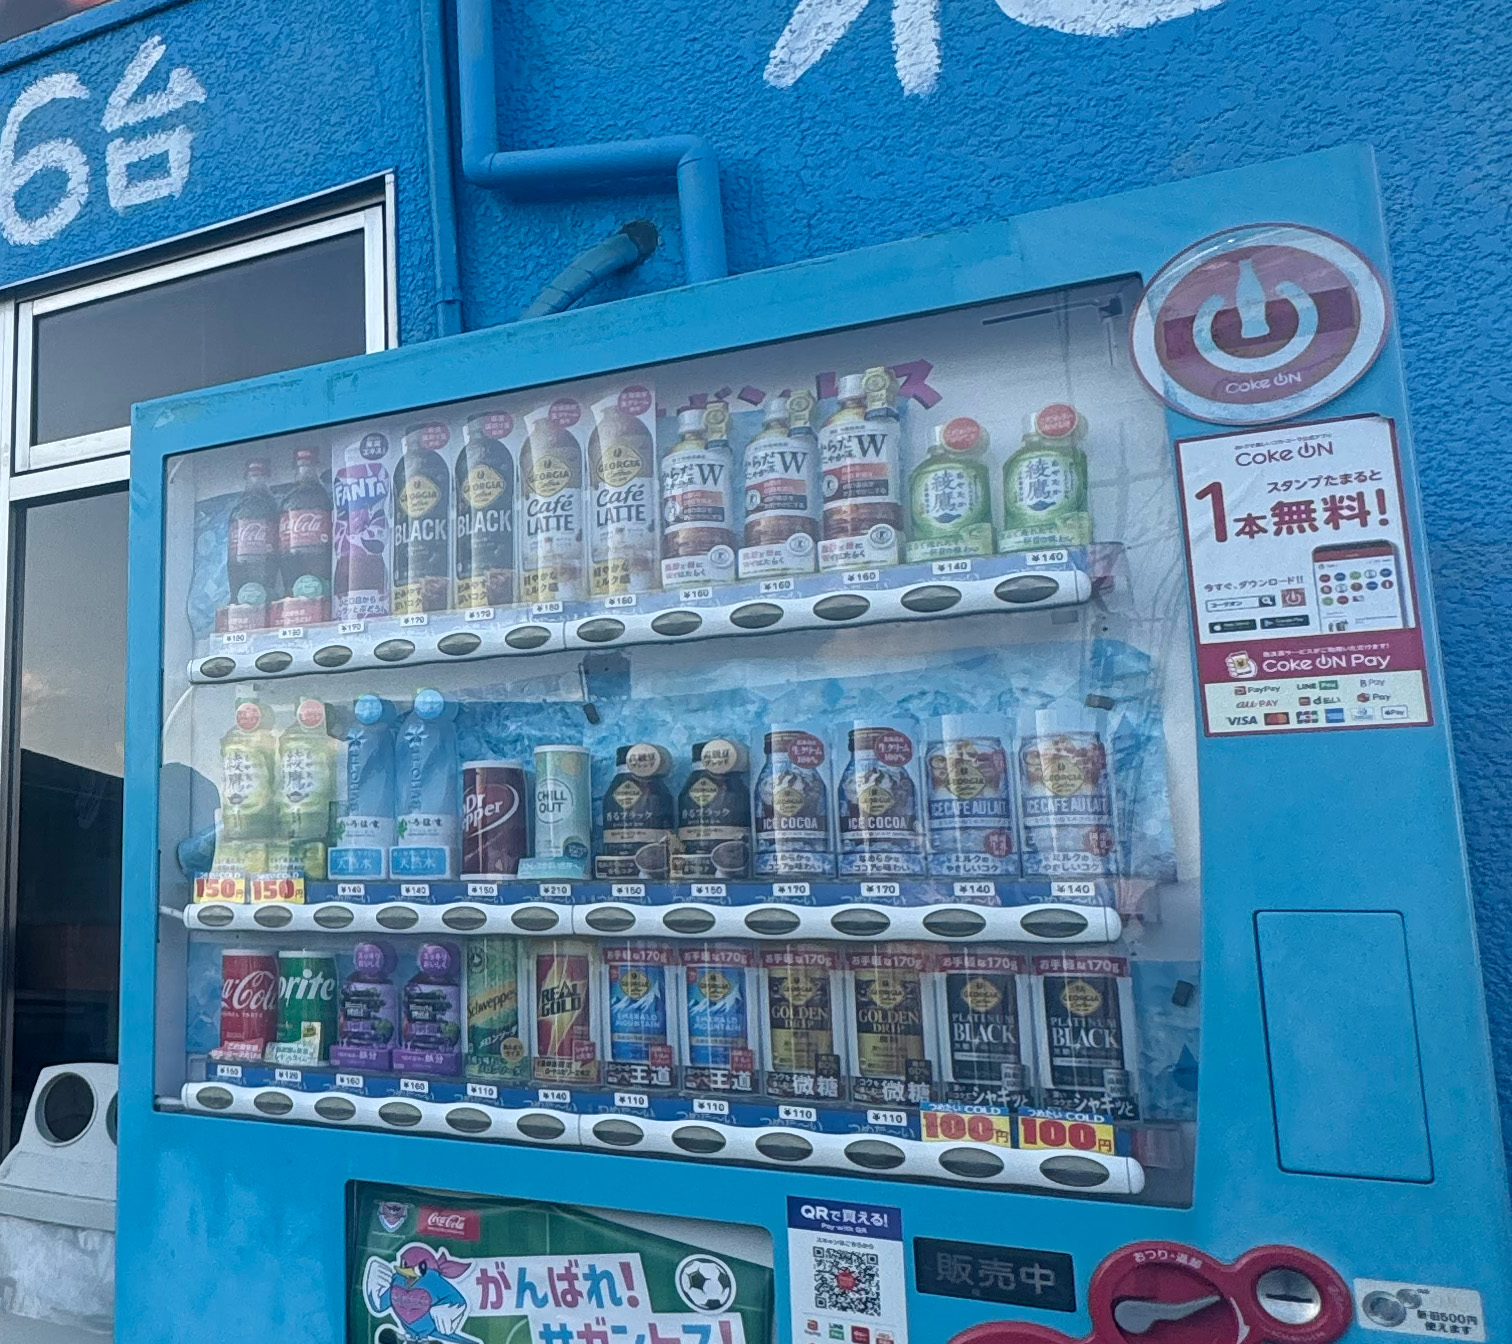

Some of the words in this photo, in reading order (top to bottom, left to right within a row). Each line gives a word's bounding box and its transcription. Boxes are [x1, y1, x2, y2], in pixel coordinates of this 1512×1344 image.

[1225, 376, 1270, 395] Coke
[857, 433, 888, 458] W
[777, 451, 808, 474] W
[1235, 448, 1293, 467] Coke
[697, 463, 725, 487] W
[1024, 458, 1052, 502] 綾鷹
[1266, 469, 1383, 494] スタンプたまると
[336, 477, 386, 506] FANTA
[597, 484, 645, 508] Café
[931, 470, 958, 513] 綾鷹
[527, 495, 573, 518] Café
[596, 503, 646, 526] LATTE
[395, 518, 447, 545] BLACK
[457, 510, 513, 538] BLACK
[526, 513, 574, 534] LATTE
[937, 561, 968, 572] ¥140
[1031, 552, 1063, 563] ¥140
[847, 572, 876, 582] ¥160
[1262, 656, 1313, 673] Coke
[1350, 653, 1392, 671] Pay
[1226, 716, 1259, 726] VISA
[536, 789, 567, 802] CHILL
[538, 802, 564, 814] OUT
[780, 816, 819, 829] COCOA
[868, 816, 908, 829] COCOA
[778, 885, 807, 894] ¥170
[866, 884, 896, 894] ¥170
[959, 884, 991, 894] ¥140
[1056, 884, 1090, 894] ¥140
[541, 981, 582, 1004] REAL
[541, 997, 581, 1017] GOLD
[771, 1005, 829, 1020] GOLDEN
[858, 1008, 920, 1024] GOLDEN
[1050, 1016, 1117, 1029] PLATINUM
[953, 1023, 1017, 1045] BLACK
[1052, 1027, 1119, 1049] BLACK
[629, 1064, 672, 1086] 王道
[710, 1069, 753, 1092] 王道
[471, 1086, 494, 1096] ¥110
[791, 1073, 839, 1098] 微糖
[881, 1080, 930, 1103] 微糖
[543, 1092, 567, 1101] ¥140
[619, 1095, 645, 1106] ¥110
[697, 1102, 725, 1112] ¥110
[784, 1108, 812, 1119] ¥110
[963, 1104, 1001, 1116] COLD
[872, 1112, 903, 1124] ¥110
[1065, 1111, 1105, 1124] COLD
[922, 1112, 1009, 1144] 100円
[1020, 1117, 1113, 1154] 100円
[936, 1251, 1055, 1295] 販売中
